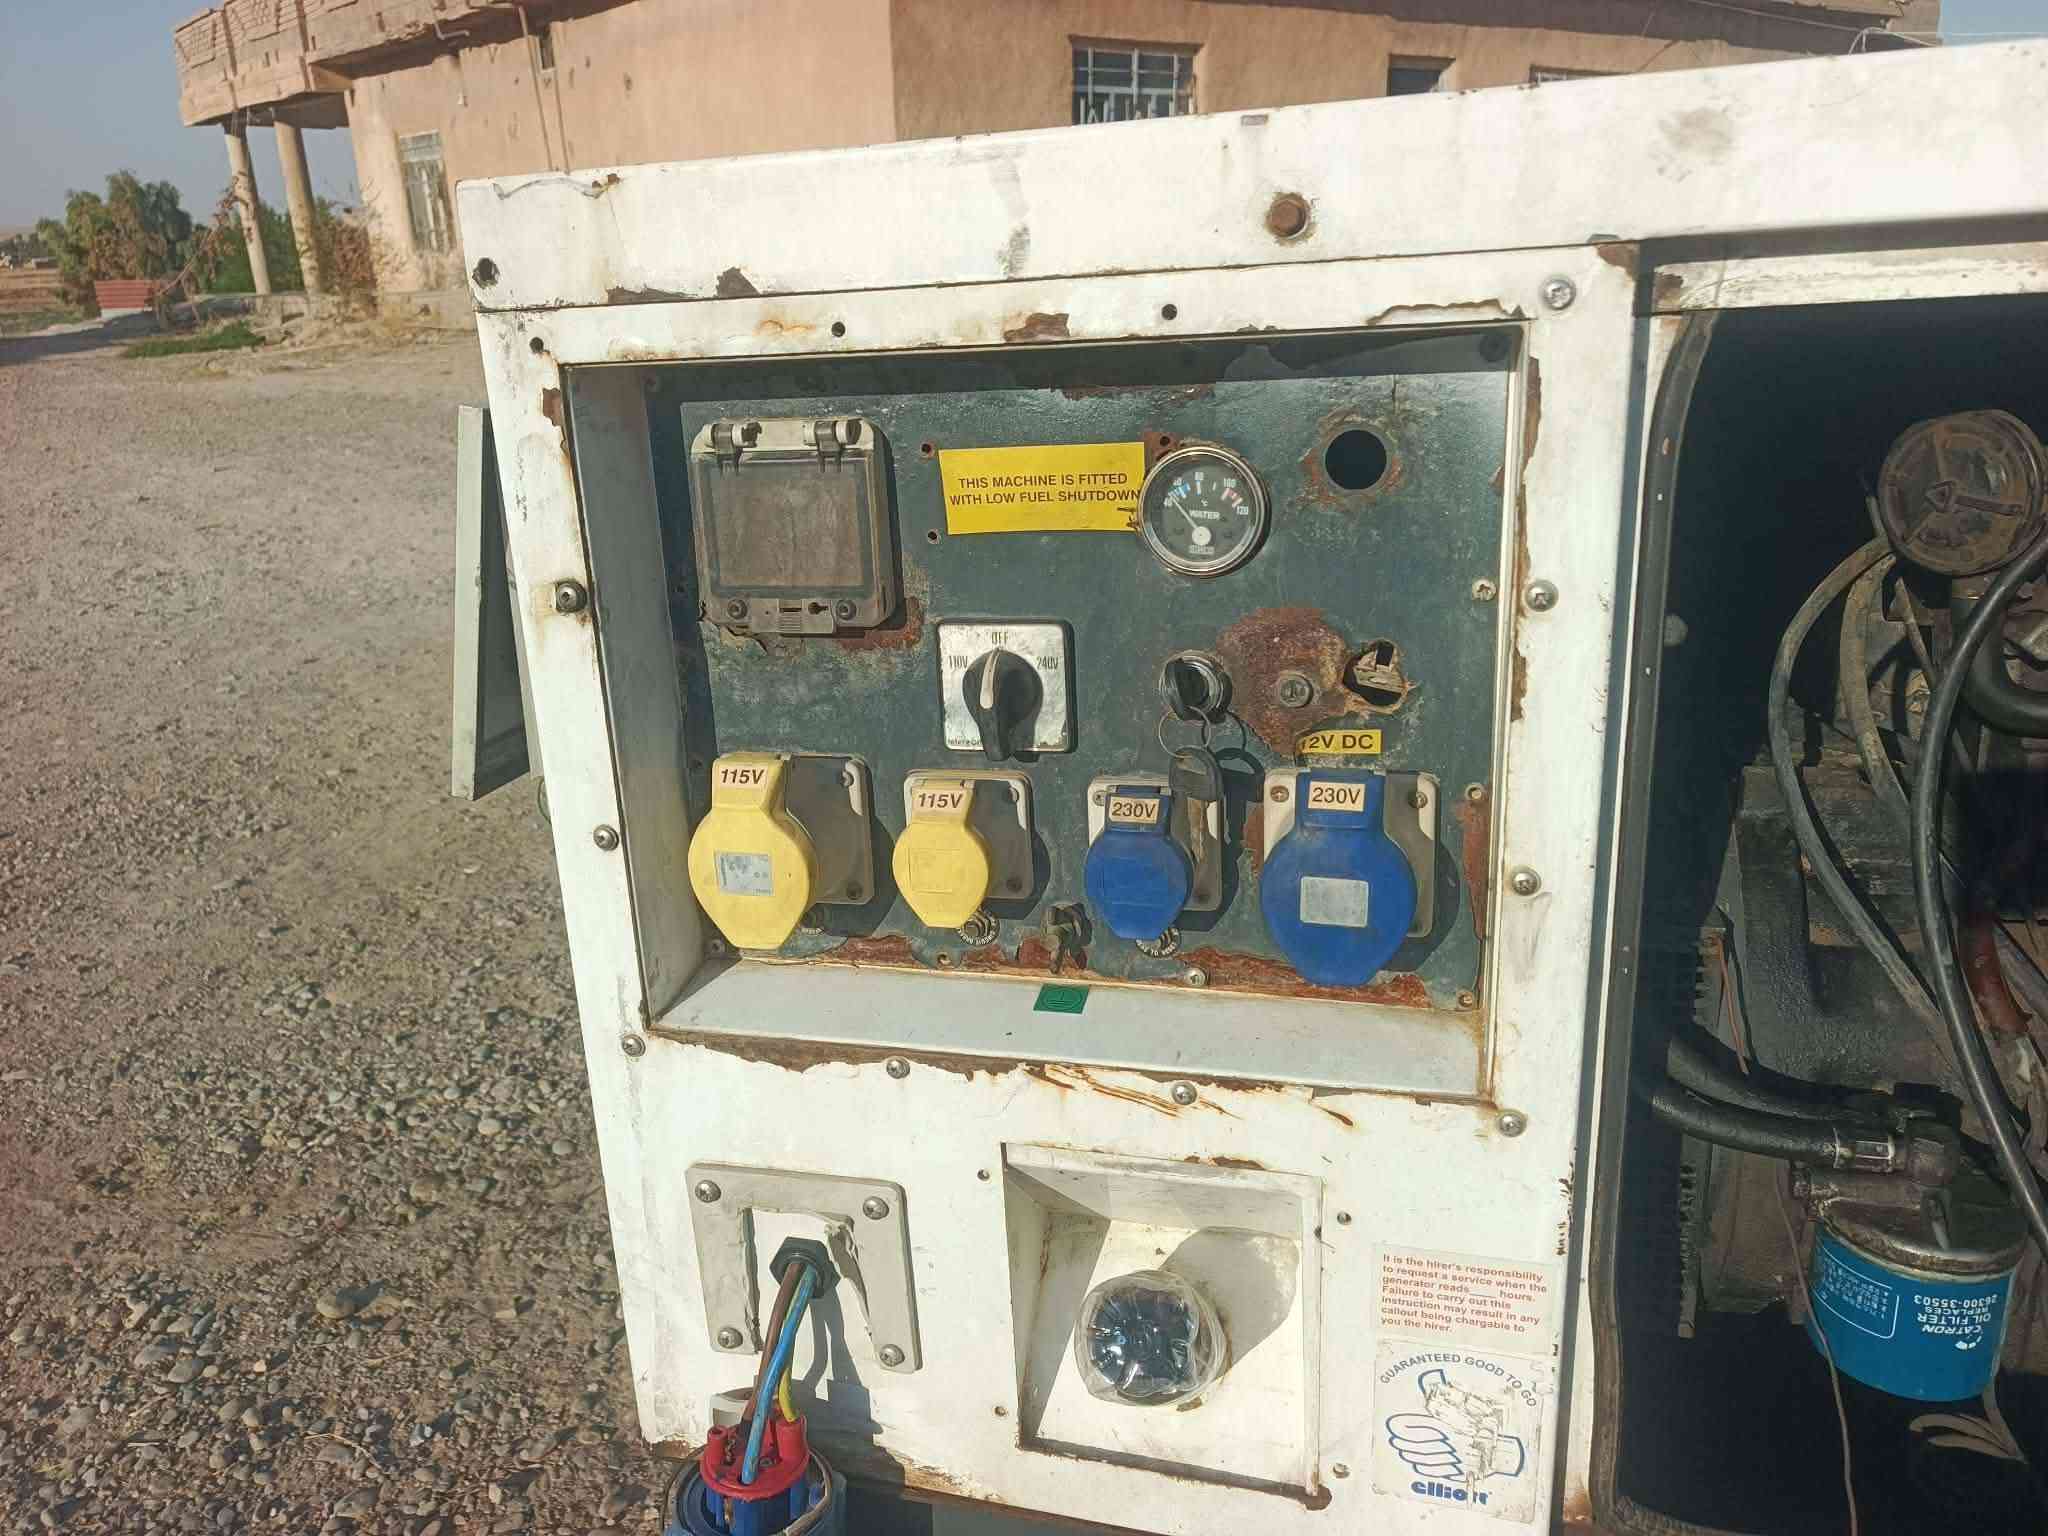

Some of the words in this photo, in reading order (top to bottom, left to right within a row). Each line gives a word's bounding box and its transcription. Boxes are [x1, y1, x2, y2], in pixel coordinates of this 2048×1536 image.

[958, 477, 989, 489] THIS
[992, 475, 1057, 488] MACHINE
[1061, 474, 1074, 486] IS
[1078, 473, 1128, 485] FITTED
[950, 493, 982, 506] WITH
[986, 492, 1015, 504] LOW
[1020, 491, 1053, 503] FUEL
[1058, 490, 1141, 502] SHUTDOWN
[1189, 509, 1220, 519] WATER
[991, 631, 1009, 644] OFF
[949, 655, 968, 669] 110V
[1036, 655, 1060, 669] 240V
[1342, 734, 1374, 749] DC
[720, 767, 766, 785] 115V
[917, 792, 963, 809] 115V
[1311, 787, 1362, 806] 230V
[1111, 802, 1157, 819] 230V
[1383, 1253, 1390, 1262] It
[1393, 1255, 1402, 1264] is
[1406, 1257, 1423, 1266] the
[1465, 1265, 1543, 1283] responsibility
[1383, 1265, 1393, 1273] to
[1397, 1268, 1438, 1279] request
[1452, 1275, 1492, 1286] service
[1496, 1279, 1526, 1289] when
[1529, 1283, 1547, 1293] the
[1382, 1276, 1435, 1289] generator
[1439, 1283, 1470, 1293] reads
[1499, 1290, 1536, 1302] hours.
[1382, 1285, 1420, 1297] Failure
[1422, 1290, 1433, 1299] to
[1436, 1294, 1465, 1305] carry
[1469, 1297, 1488, 1306] out
[1490, 1299, 1512, 1309] this
[1382, 1295, 1441, 1310] instruction
[1443, 1305, 1467, 1315] may
[1471, 1308, 1503, 1319] result
[1506, 1311, 1517, 1321] in
[1520, 1315, 1540, 1325] any
[1924, 1306, 1989, 1315] REPLACES
[1974, 1312, 1991, 1322] OIL
[1381, 1307, 1418, 1317] callout
[1420, 1310, 1452, 1323] being
[1455, 1316, 1510, 1330] chargable
[1514, 1324, 1525, 1332] to
[1381, 1317, 1401, 1325] you
[1404, 1318, 1421, 1327] the
[1424, 1320, 1453, 1333] hirer.
[1917, 1313, 1969, 1325] FILTER
[1380, 1352, 1461, 1384] GUARANTEED
[1464, 1356, 1505, 1377] GOOD
[1506, 1374, 1522, 1389] TO
[1521, 1389, 1537, 1408] GO
